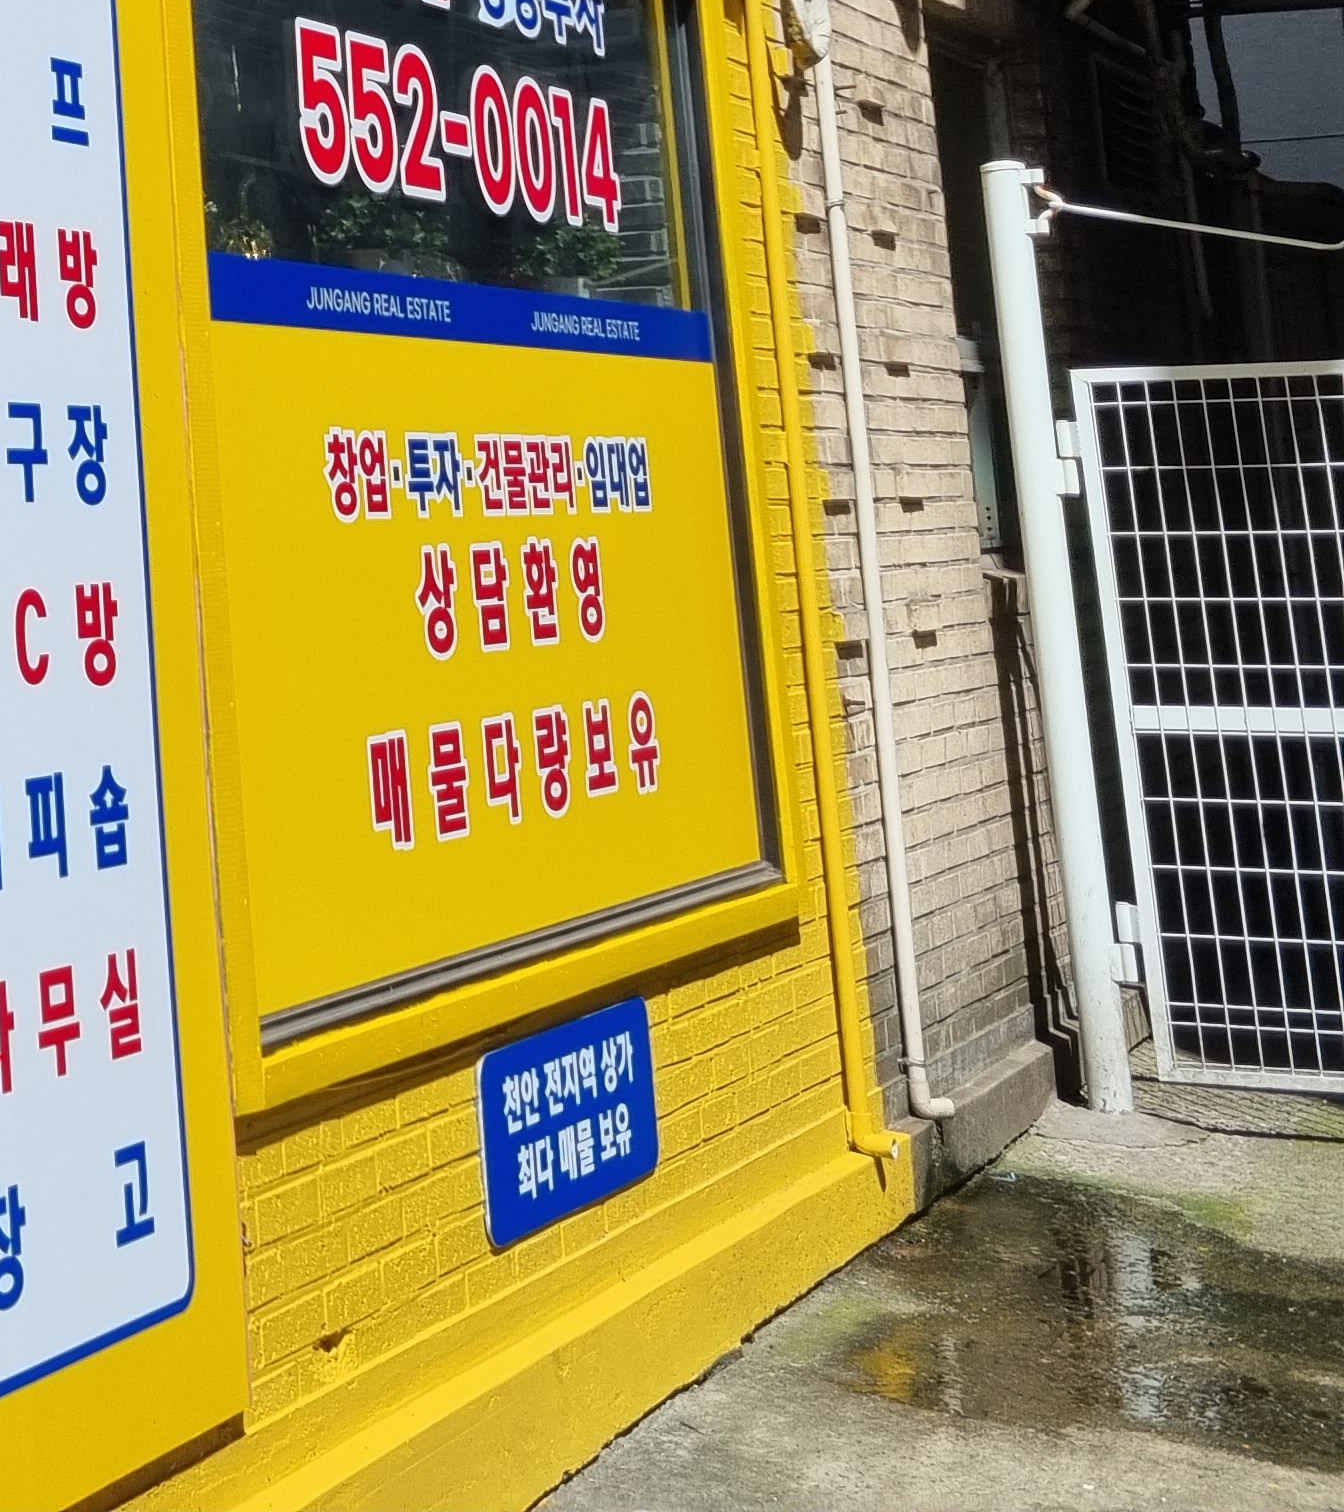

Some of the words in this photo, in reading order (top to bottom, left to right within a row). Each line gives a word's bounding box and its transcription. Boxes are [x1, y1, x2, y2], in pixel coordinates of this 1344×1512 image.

[295, 16, 622, 232] 552-0014
[306, 287, 371, 315] JUNGANG
[374, 293, 405, 319] REAL
[407, 296, 451, 323] ESTATE
[530, 311, 580, 335] JUNGANG
[581, 316, 606, 338] REAL
[606, 318, 640, 340] ESTATE
[415, 535, 607, 662] 상담환영
[367, 690, 662, 851] 매물다량보유
[502, 1068, 540, 1135] 천안
[543, 1045, 598, 1116] 전지역
[601, 1031, 634, 1092] 상가
[517, 1135, 555, 1199] 최다
[558, 1118, 595, 1181] 매물
[598, 1103, 632, 1162] 보유
